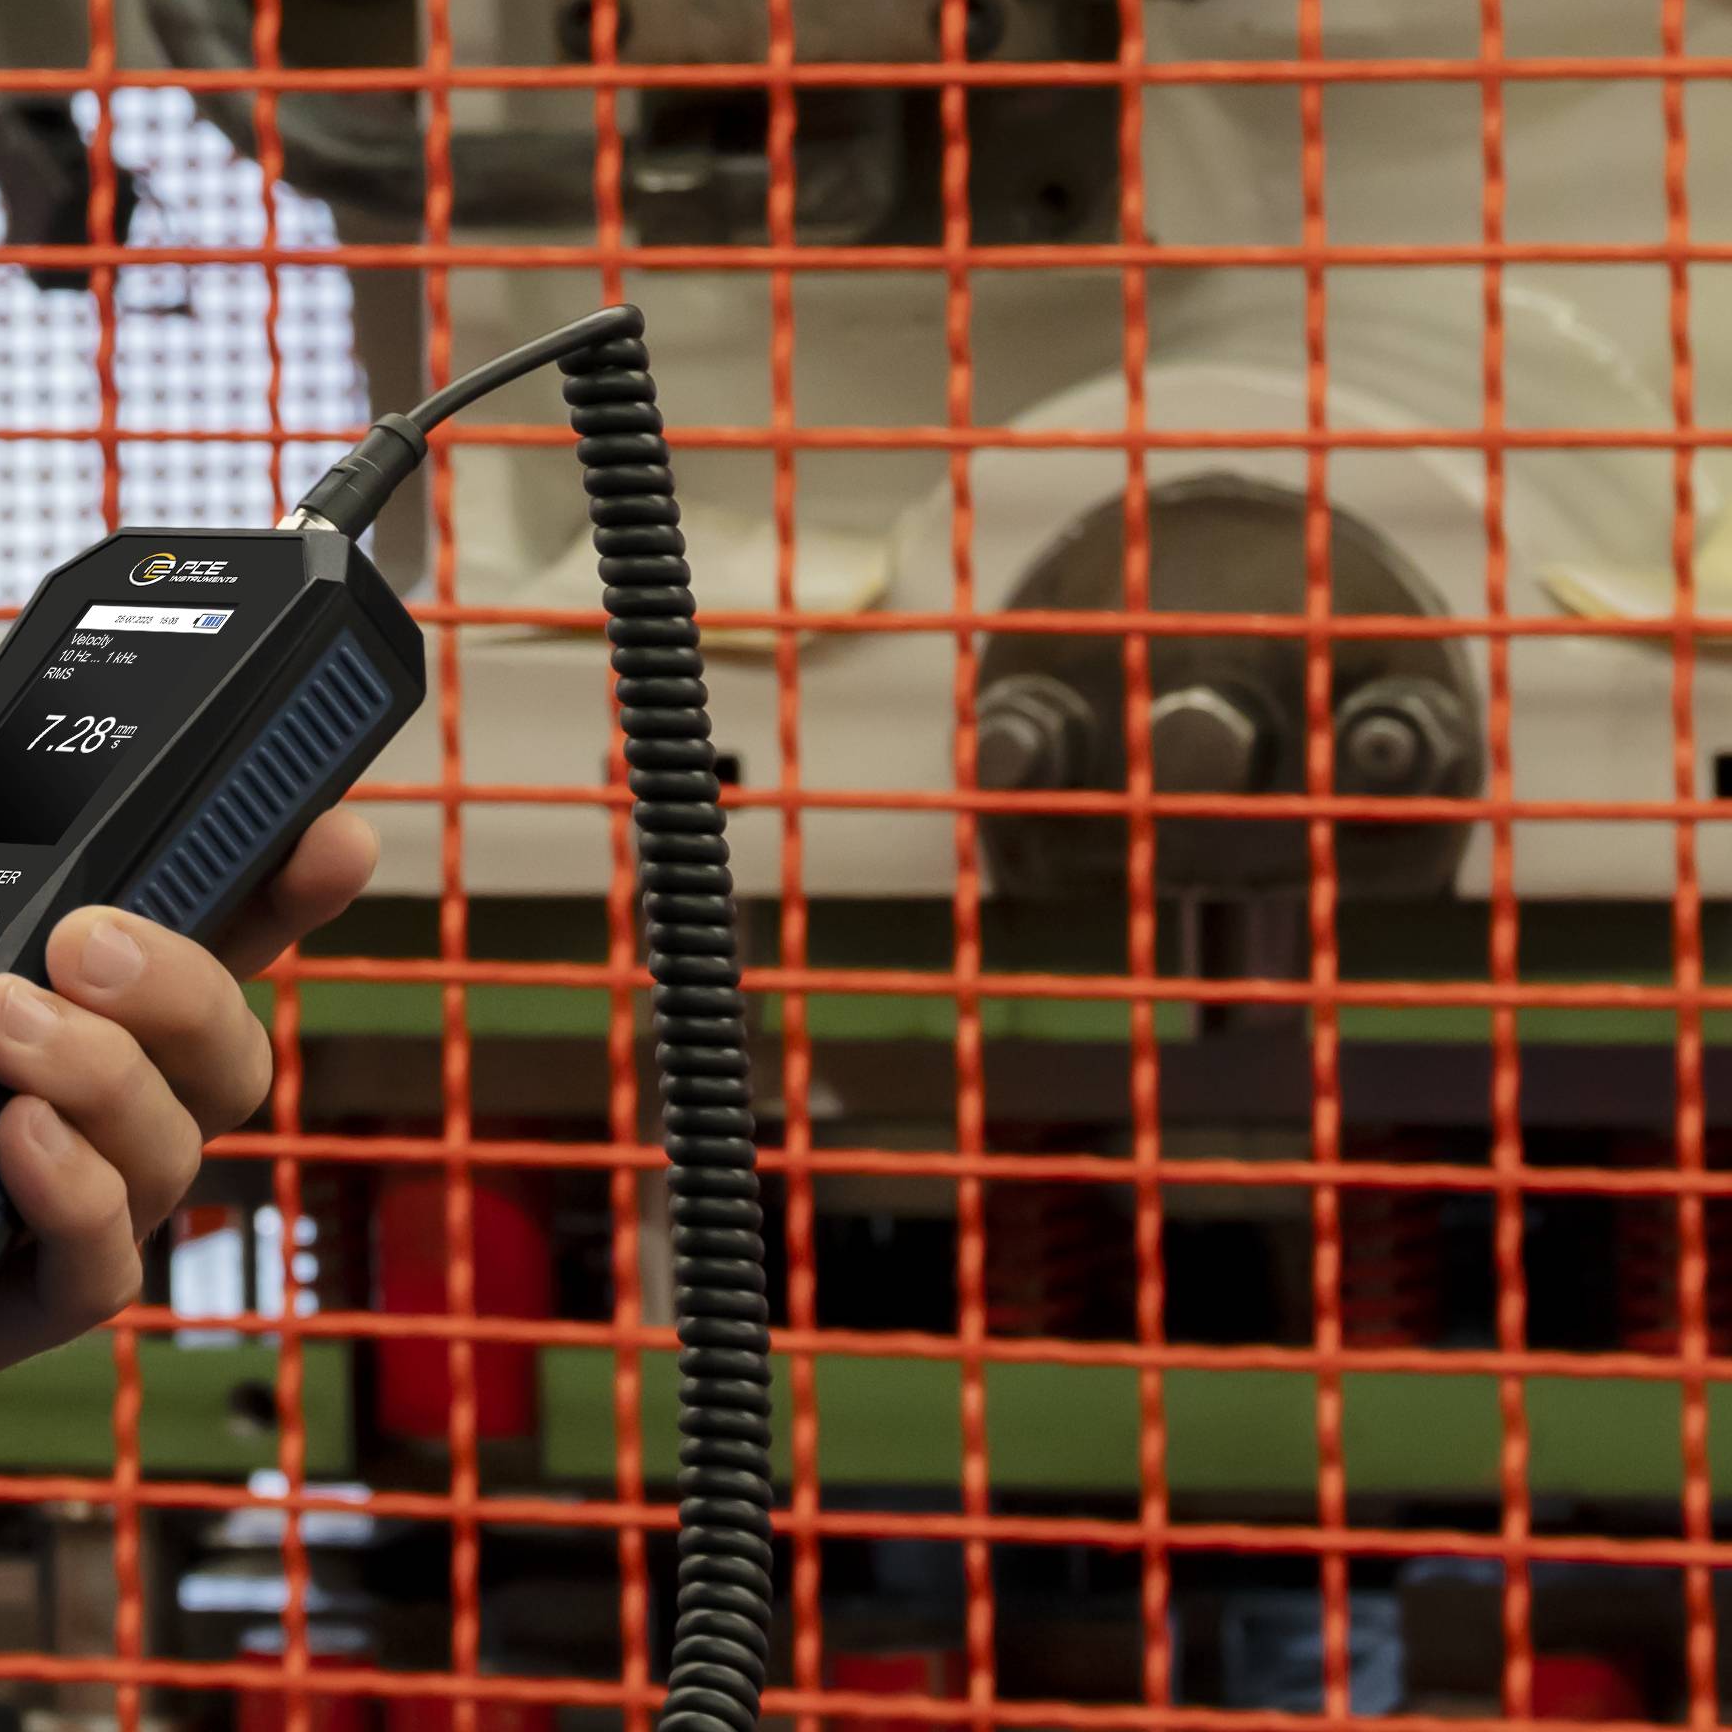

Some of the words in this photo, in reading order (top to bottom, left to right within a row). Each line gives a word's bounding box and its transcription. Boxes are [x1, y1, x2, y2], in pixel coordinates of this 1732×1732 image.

[176, 560, 229, 576] PCE
[168, 575, 239, 584] INSTRUMENTS
[71, 633, 114, 649] Velocity
[58, 649, 76, 662] 10
[105, 651, 116, 664] 1
[112, 651, 139, 665] kHz
[42, 666, 75, 680] RMS
[26, 714, 117, 754] 7.28
[113, 724, 139, 736] mm
